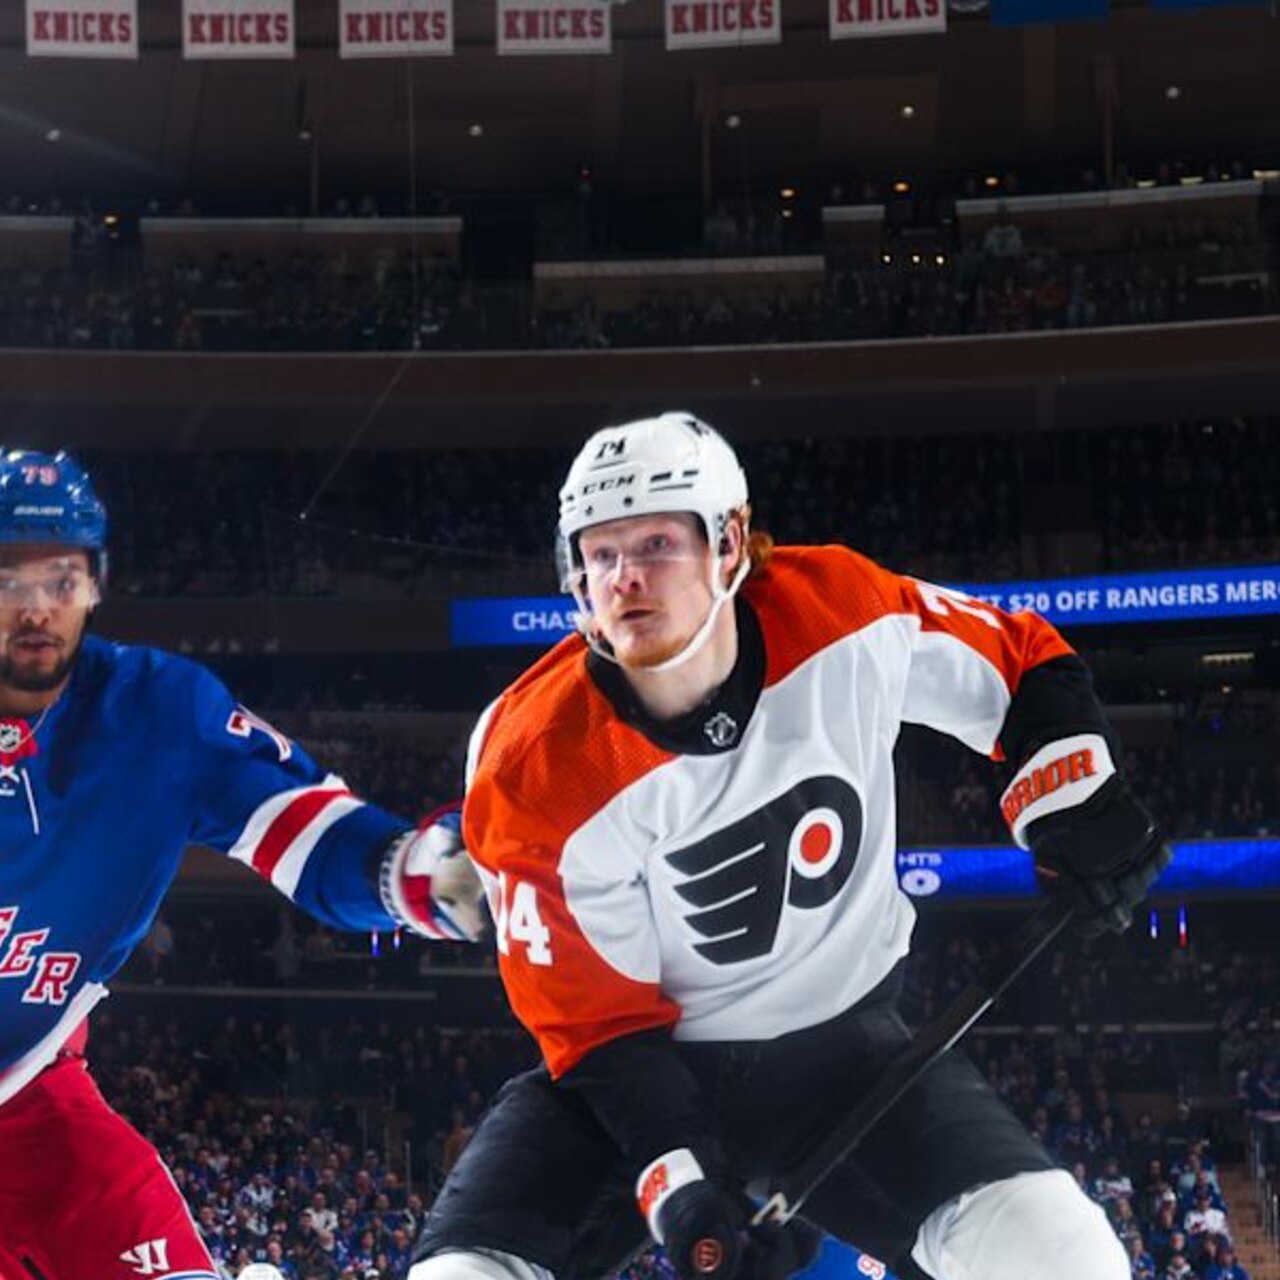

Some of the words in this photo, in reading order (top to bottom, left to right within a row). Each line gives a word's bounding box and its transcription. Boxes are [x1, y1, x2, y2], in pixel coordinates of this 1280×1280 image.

[33, 12, 132, 42] KNICKS
[503, 9, 605, 39] KNICKS
[671, 1, 774, 35] KNICKS
[836, 0, 940, 24] KNICKS
[188, 14, 289, 43] KNICKS
[345, 12, 446, 43] KNICKS
[582, 474, 635, 494] CCM
[1009, 592, 1050, 613] $20
[1055, 589, 1100, 612] OFF
[1106, 583, 1219, 609] RANGERS
[1225, 579, 1280, 602] MER
